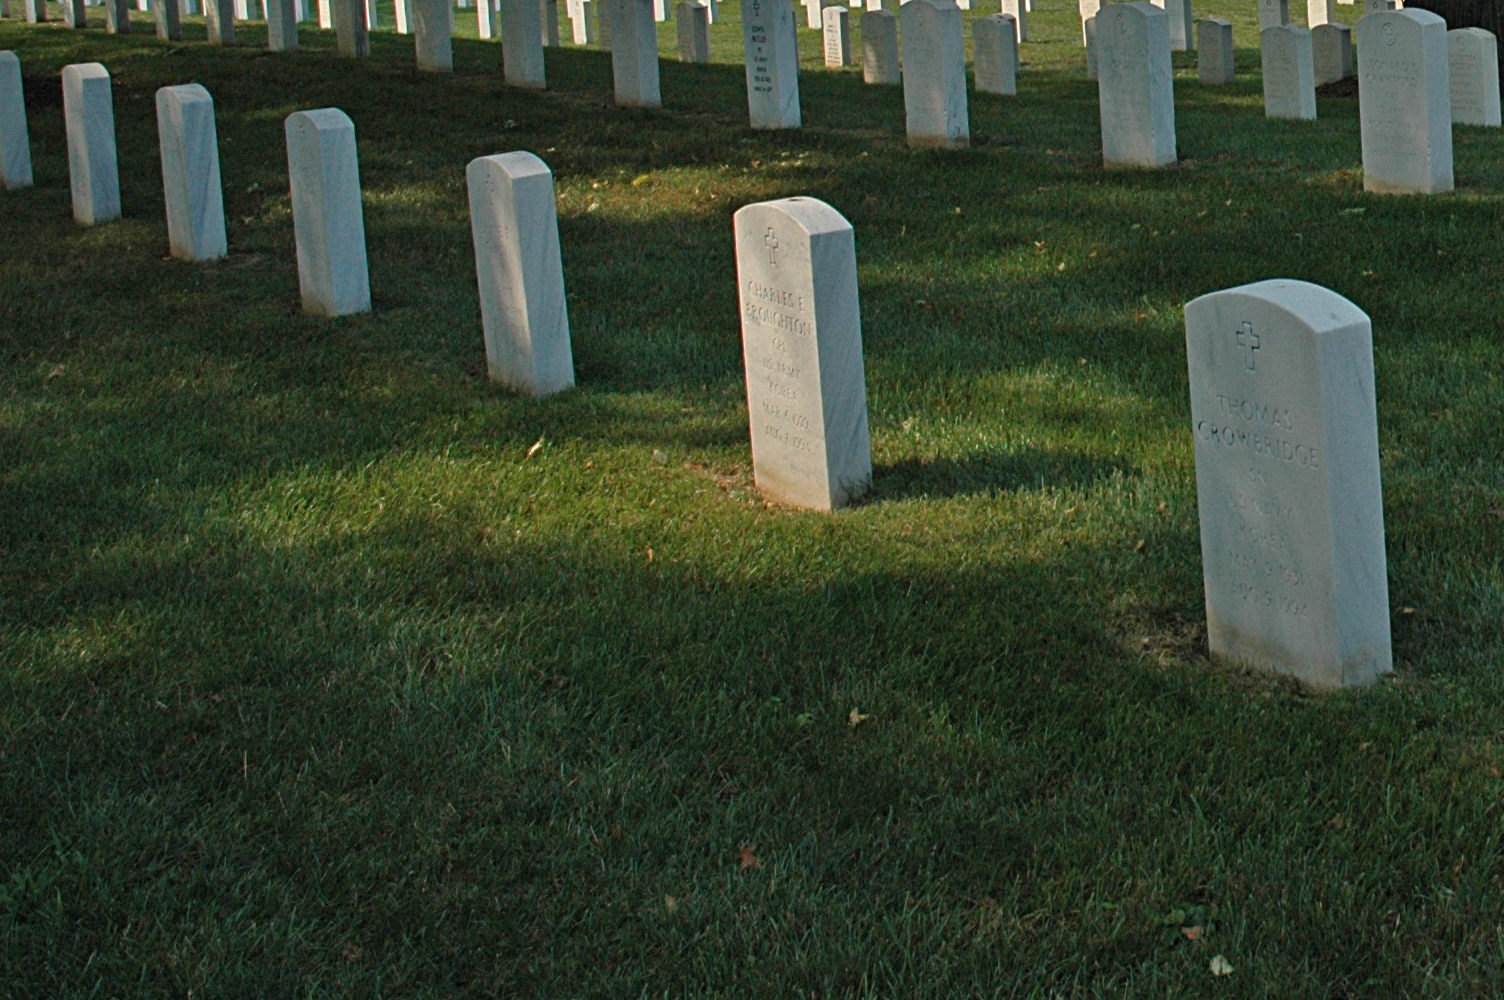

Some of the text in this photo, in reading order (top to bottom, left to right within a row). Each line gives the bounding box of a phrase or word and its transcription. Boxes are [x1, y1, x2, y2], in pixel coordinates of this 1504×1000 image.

[747, 280, 806, 312] CHARLES E
[745, 302, 811, 338] BROUGHTON
[777, 361, 802, 381] ARMY
[768, 379, 798, 401] KOREA
[1216, 393, 1294, 432] THOMAS
[1197, 420, 1320, 470] CROWBRIDGE
[1251, 498, 1294, 519] NAVY
[1237, 519, 1288, 552] KOREA
[1228, 550, 1260, 570] MAY
[1230, 580, 1260, 605] AUG
